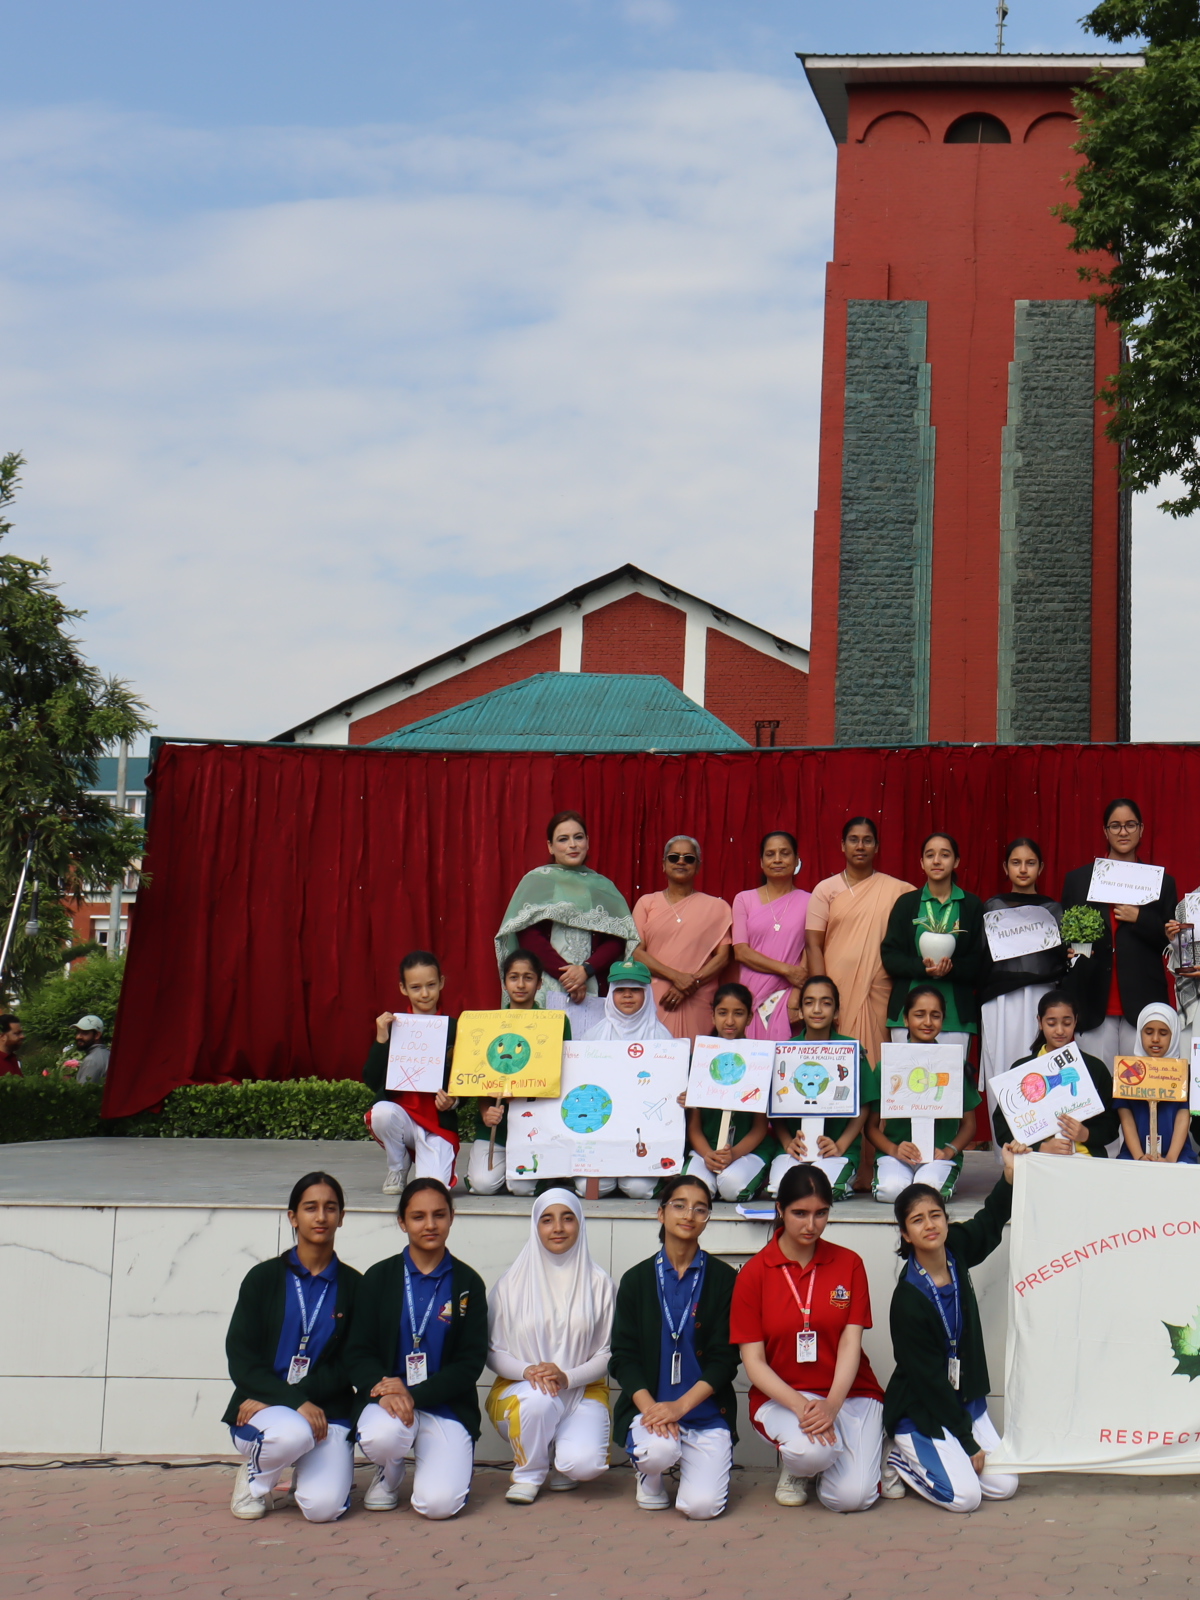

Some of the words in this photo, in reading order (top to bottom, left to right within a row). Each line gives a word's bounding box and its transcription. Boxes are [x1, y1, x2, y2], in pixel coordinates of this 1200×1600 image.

[997, 921, 1045, 939] HUMANITY
[396, 1018, 418, 1028] SAY
[426, 1019, 443, 1029] NO
[410, 1030, 423, 1039] TO
[401, 1041, 428, 1051] LOUD
[775, 1046, 797, 1055] STOP
[797, 1046, 820, 1055] NOISE
[820, 1046, 855, 1055] POLLUTION
[390, 1055, 442, 1065] SPEAKERS
[456, 1073, 486, 1085] STOP
[481, 1080, 504, 1090] NOISE
[1119, 1085, 1156, 1098] SILENCE
[1158, 1087, 1177, 1099] PLZ
[911, 1103, 944, 1111] POLLUTION
[1013, 1109, 1037, 1129] STOP
[1023, 1118, 1049, 1138] NOISE
[1014, 1224, 1158, 1298] PRESENTATION
